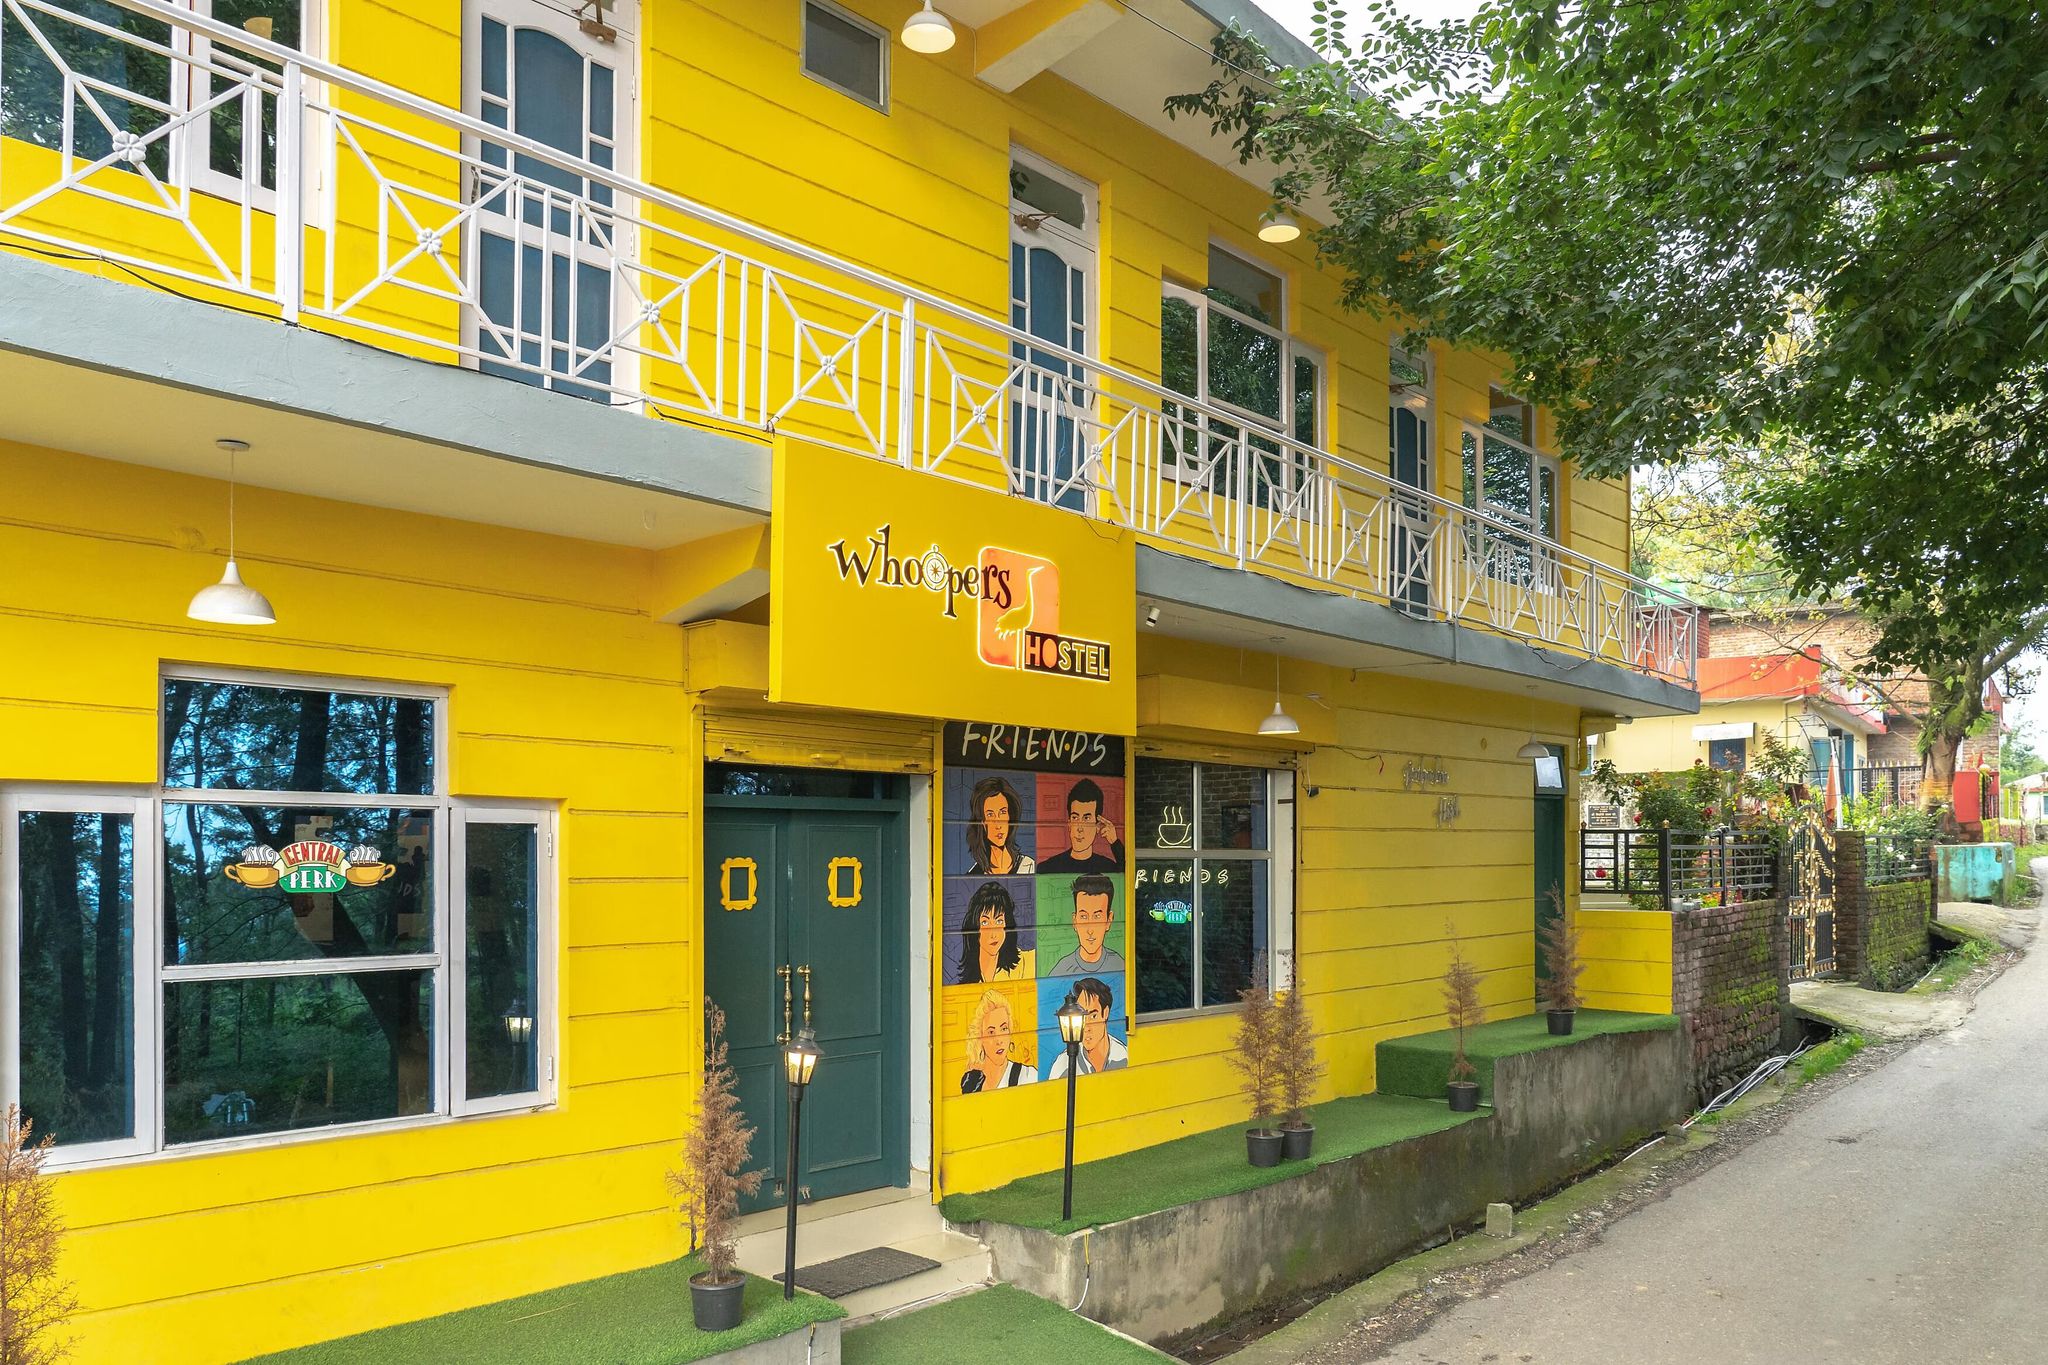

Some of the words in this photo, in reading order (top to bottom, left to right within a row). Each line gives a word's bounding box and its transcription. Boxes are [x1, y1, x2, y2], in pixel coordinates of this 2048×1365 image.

[829, 524, 1012, 618] Whoopers
[1025, 634, 1110, 677] HOSTEL
[283, 841, 341, 866] CENTRAL
